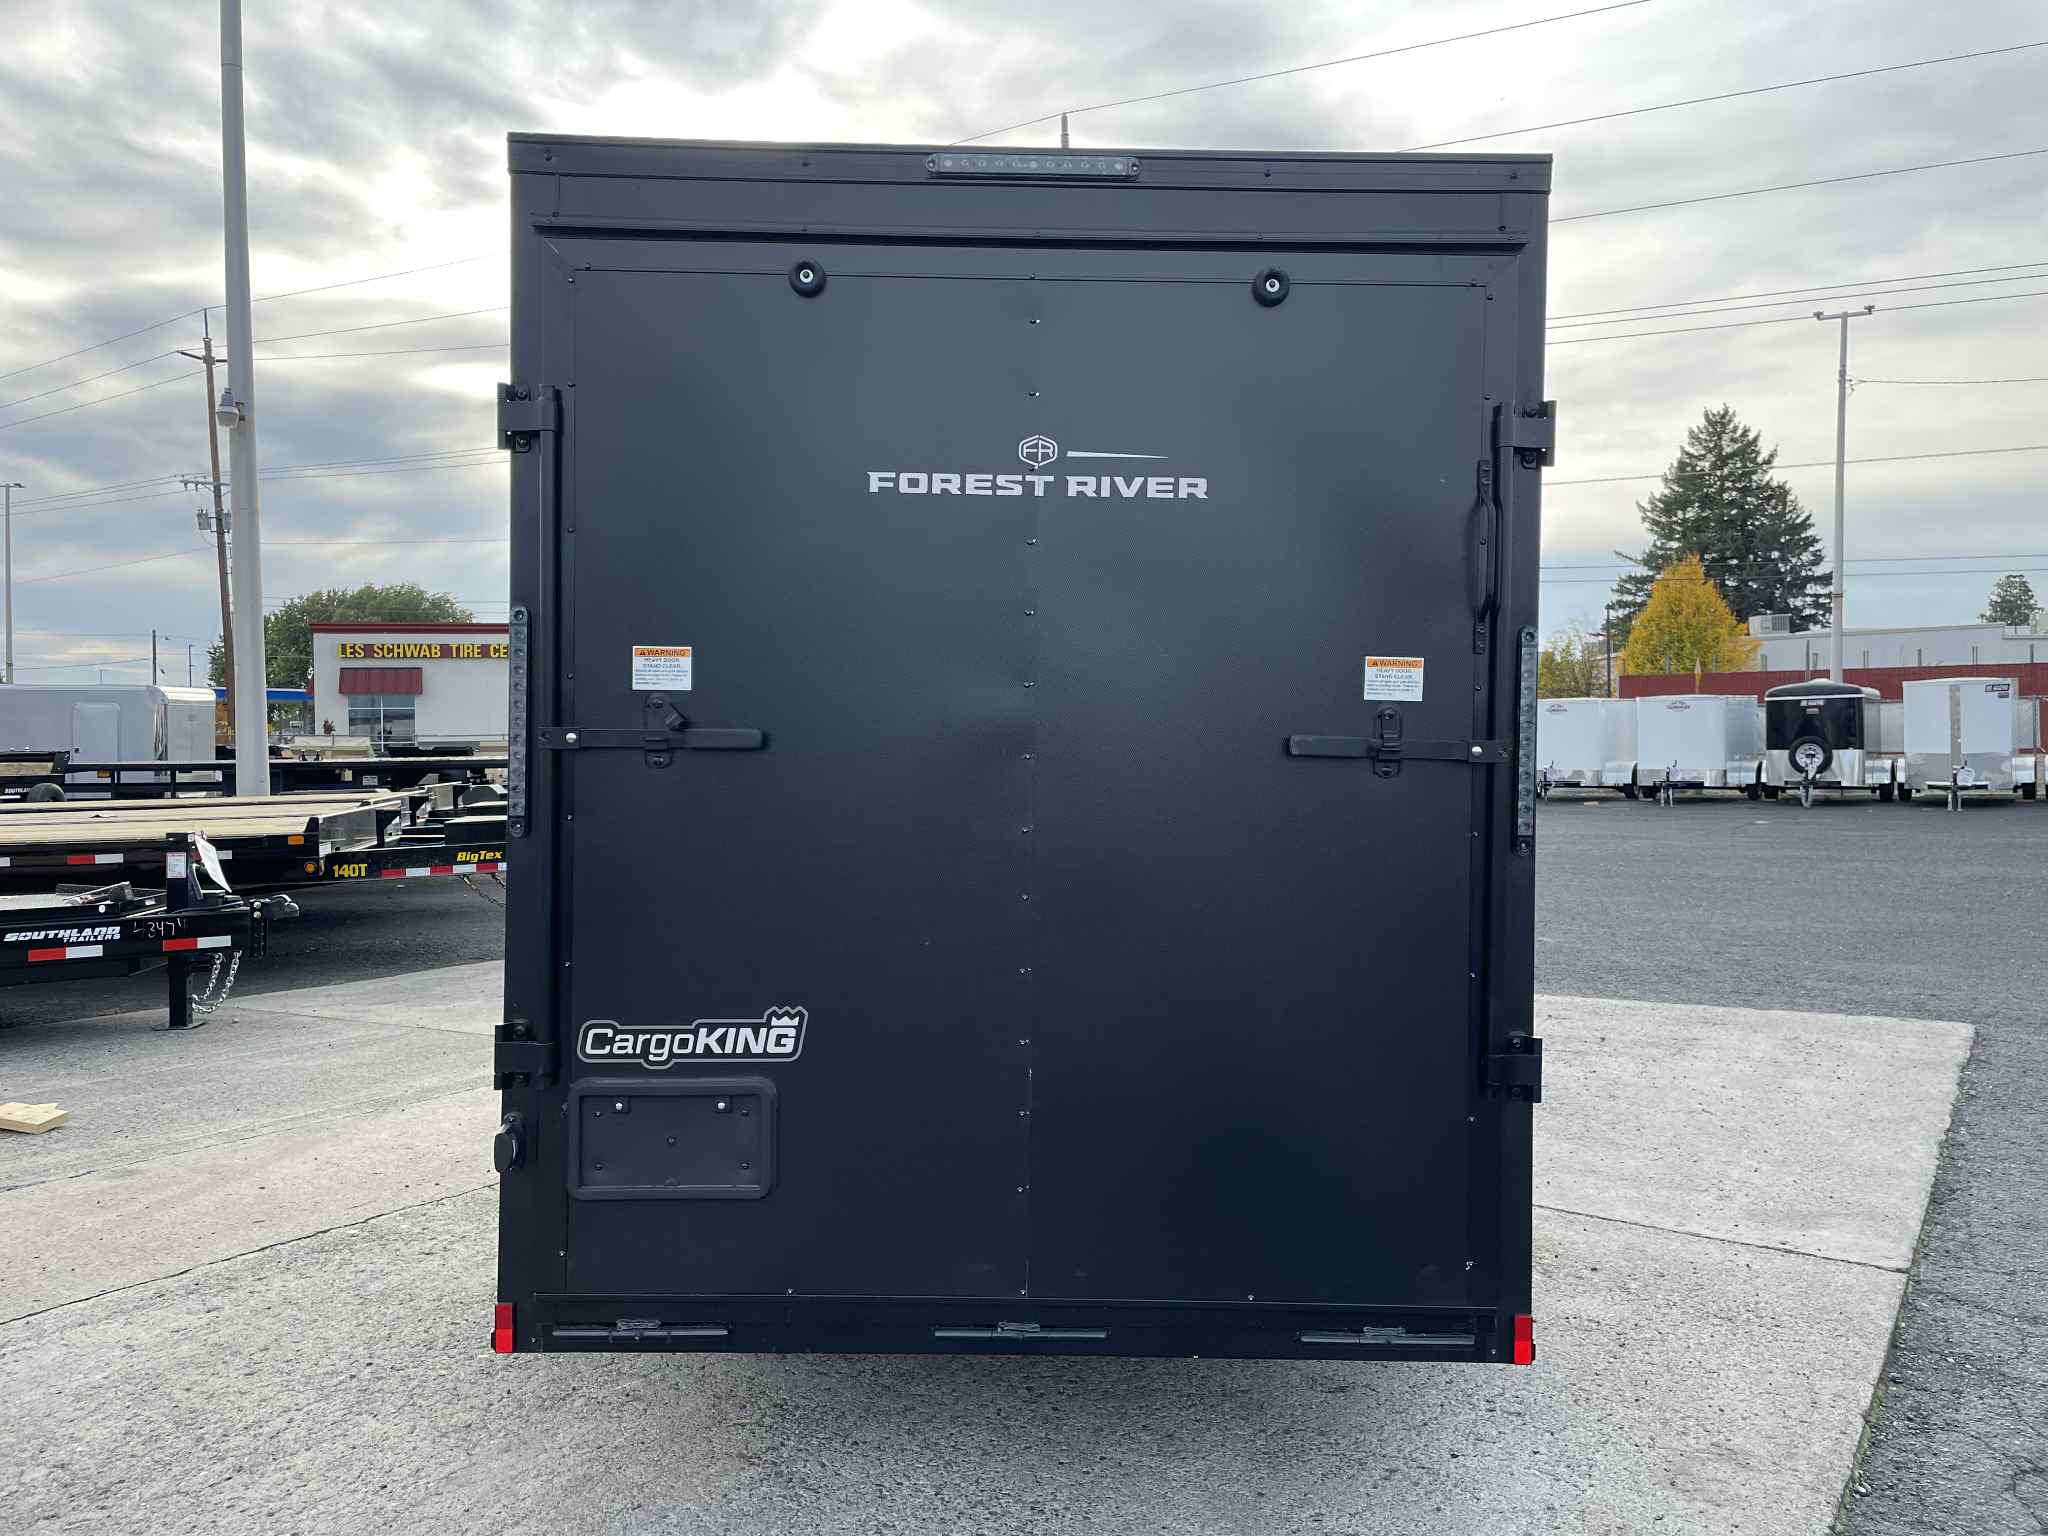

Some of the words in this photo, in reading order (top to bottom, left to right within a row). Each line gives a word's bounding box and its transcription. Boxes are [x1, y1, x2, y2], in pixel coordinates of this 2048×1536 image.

[867, 471, 1055, 497] FOREST
[1064, 475, 1208, 499] RIVER
[337, 640, 365, 658] LES
[373, 642, 441, 658] SCHWAB
[449, 642, 482, 658] TIRE
[646, 648, 686, 657] WARNING
[1378, 659, 1419, 668] WARNING
[456, 850, 503, 863] BigTex
[332, 863, 368, 878] 140T
[3, 926, 121, 942] SOUTHLAND
[63, 933, 121, 943] TRAILERS
[585, 1027, 797, 1061] CargoKING
